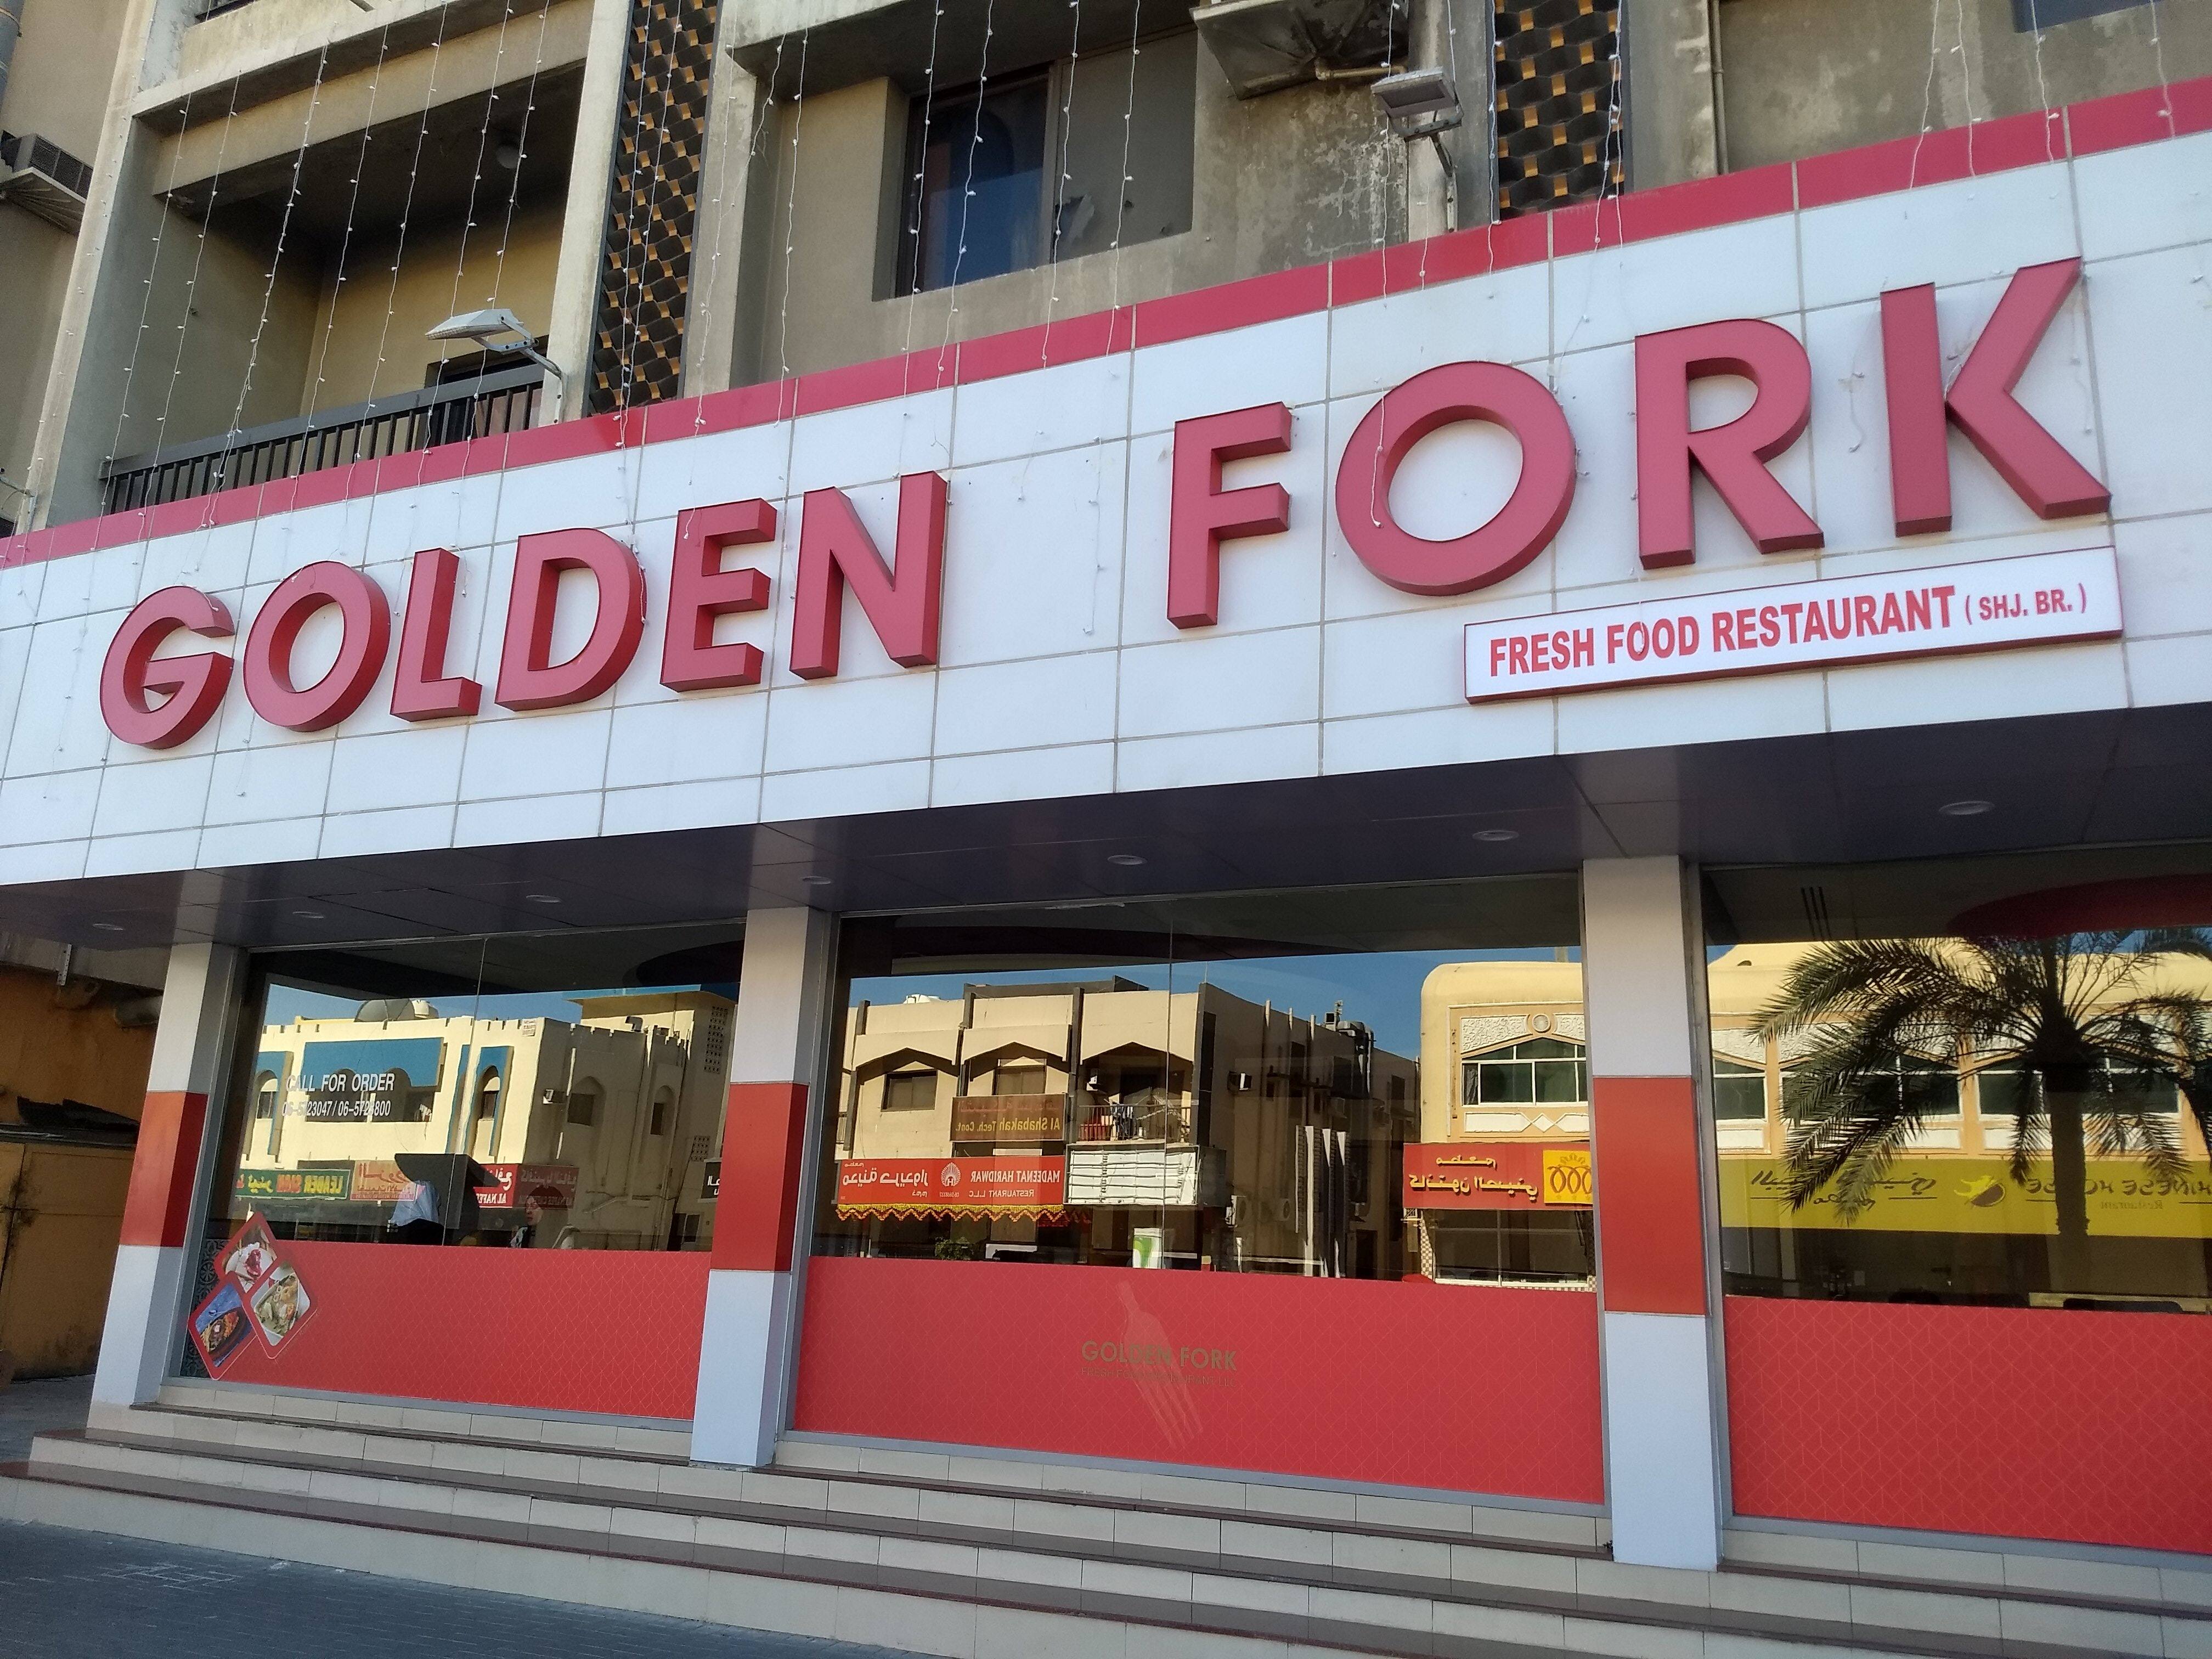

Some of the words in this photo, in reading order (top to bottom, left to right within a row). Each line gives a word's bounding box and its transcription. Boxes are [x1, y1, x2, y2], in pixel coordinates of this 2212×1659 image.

[99, 470, 949, 751] GOLDEN
[1167, 256, 2112, 630] FORK
[1489, 628, 1595, 678] FRESH
[1606, 616, 1700, 662] FOOD
[1712, 585, 1955, 653] RESTAURANT
[286, 1074, 316, 1092] CALL
[321, 1074, 347, 1092] FOR
[352, 1073, 395, 1092] ORDER
[1081, 1340, 1172, 1367] GOLDEN
[1180, 1347, 1238, 1371] FORK
